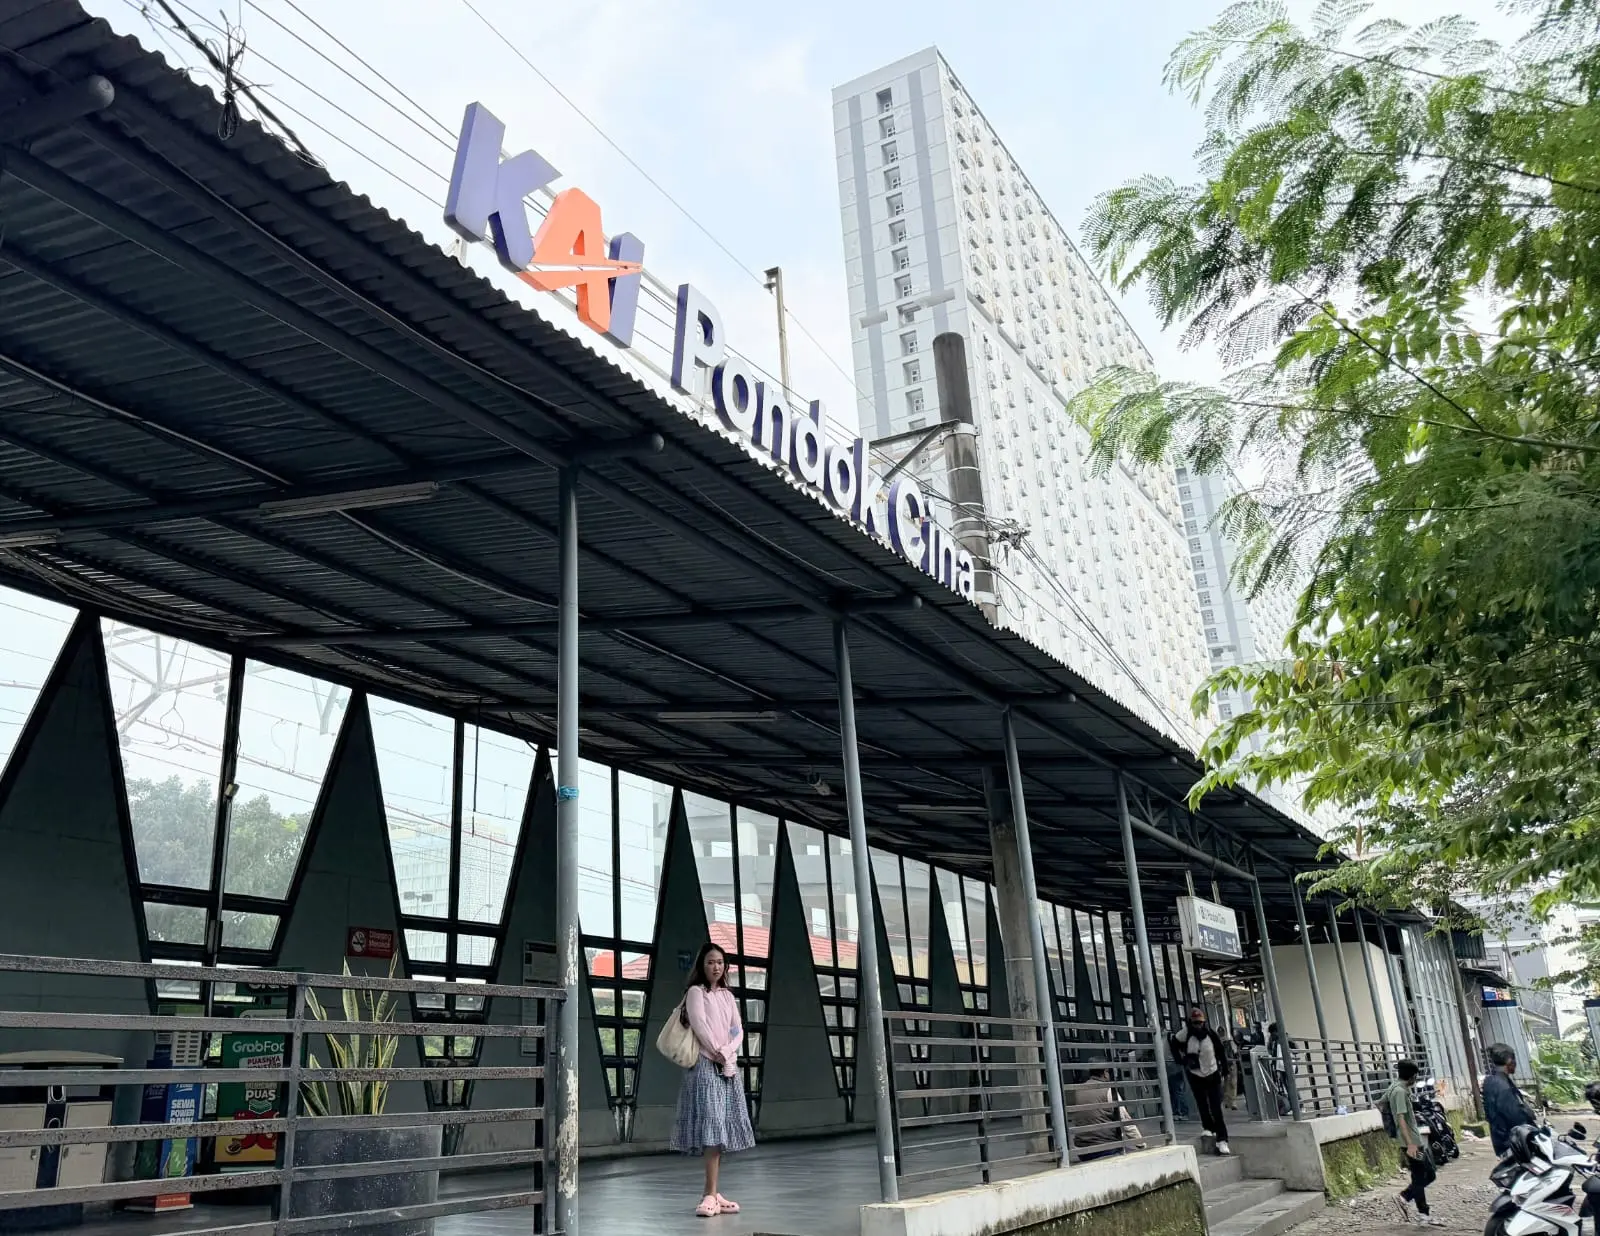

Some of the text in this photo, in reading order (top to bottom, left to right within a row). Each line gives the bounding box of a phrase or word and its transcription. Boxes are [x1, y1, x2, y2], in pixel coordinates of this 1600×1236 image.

[443, 101, 645, 349] KAI
[671, 283, 976, 606] Pondok Cina
[245, 1089, 276, 1101] PUAS
[171, 1099, 195, 1109] SEWA
[169, 1109, 195, 1118] POWER
